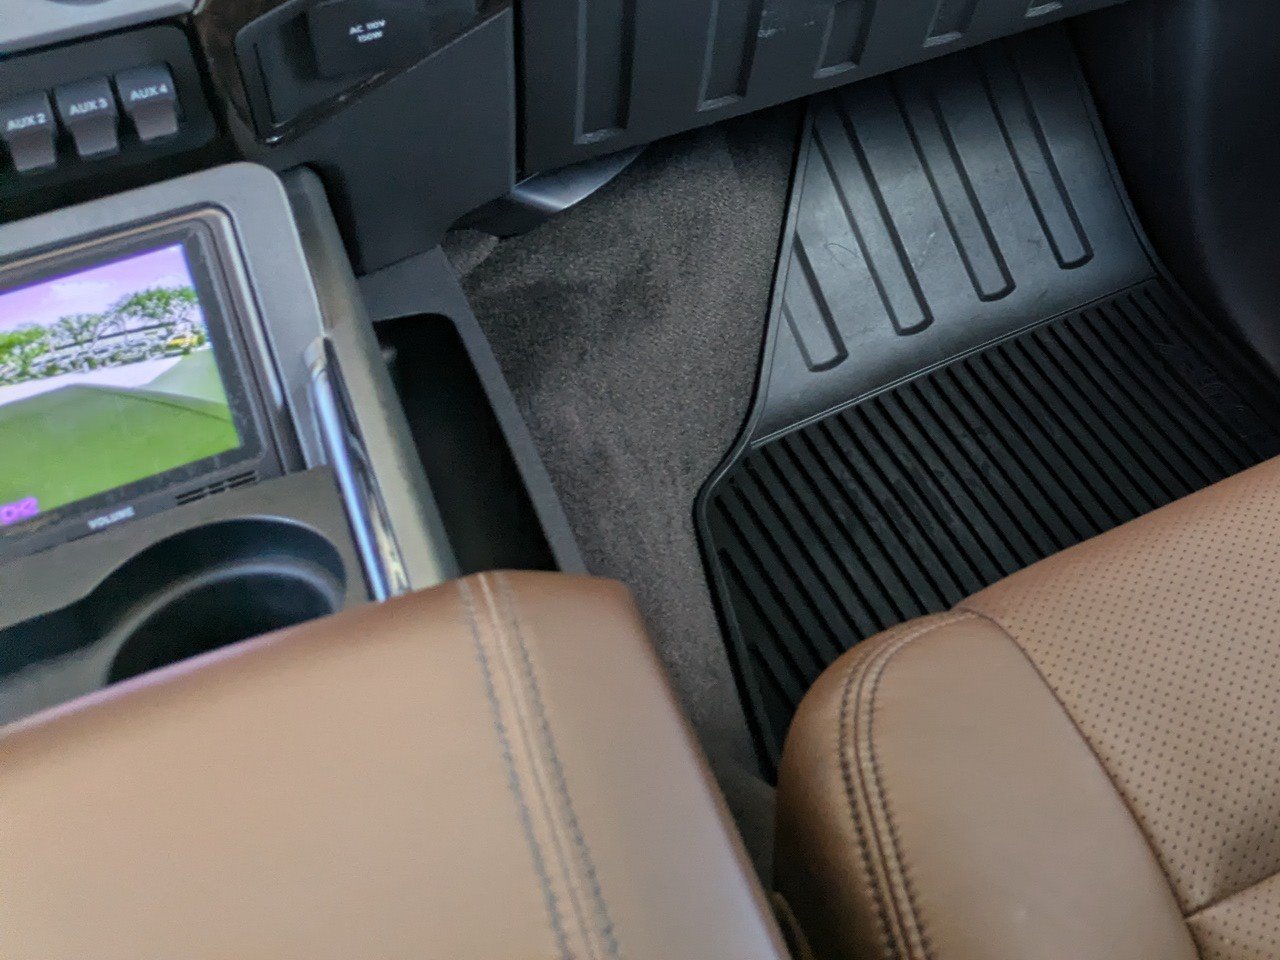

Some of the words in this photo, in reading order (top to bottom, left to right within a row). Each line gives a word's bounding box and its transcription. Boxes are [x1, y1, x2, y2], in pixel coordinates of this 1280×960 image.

[130, 87, 158, 101] AUX
[69, 100, 97, 116] AUX
[6, 115, 35, 131] AUX
